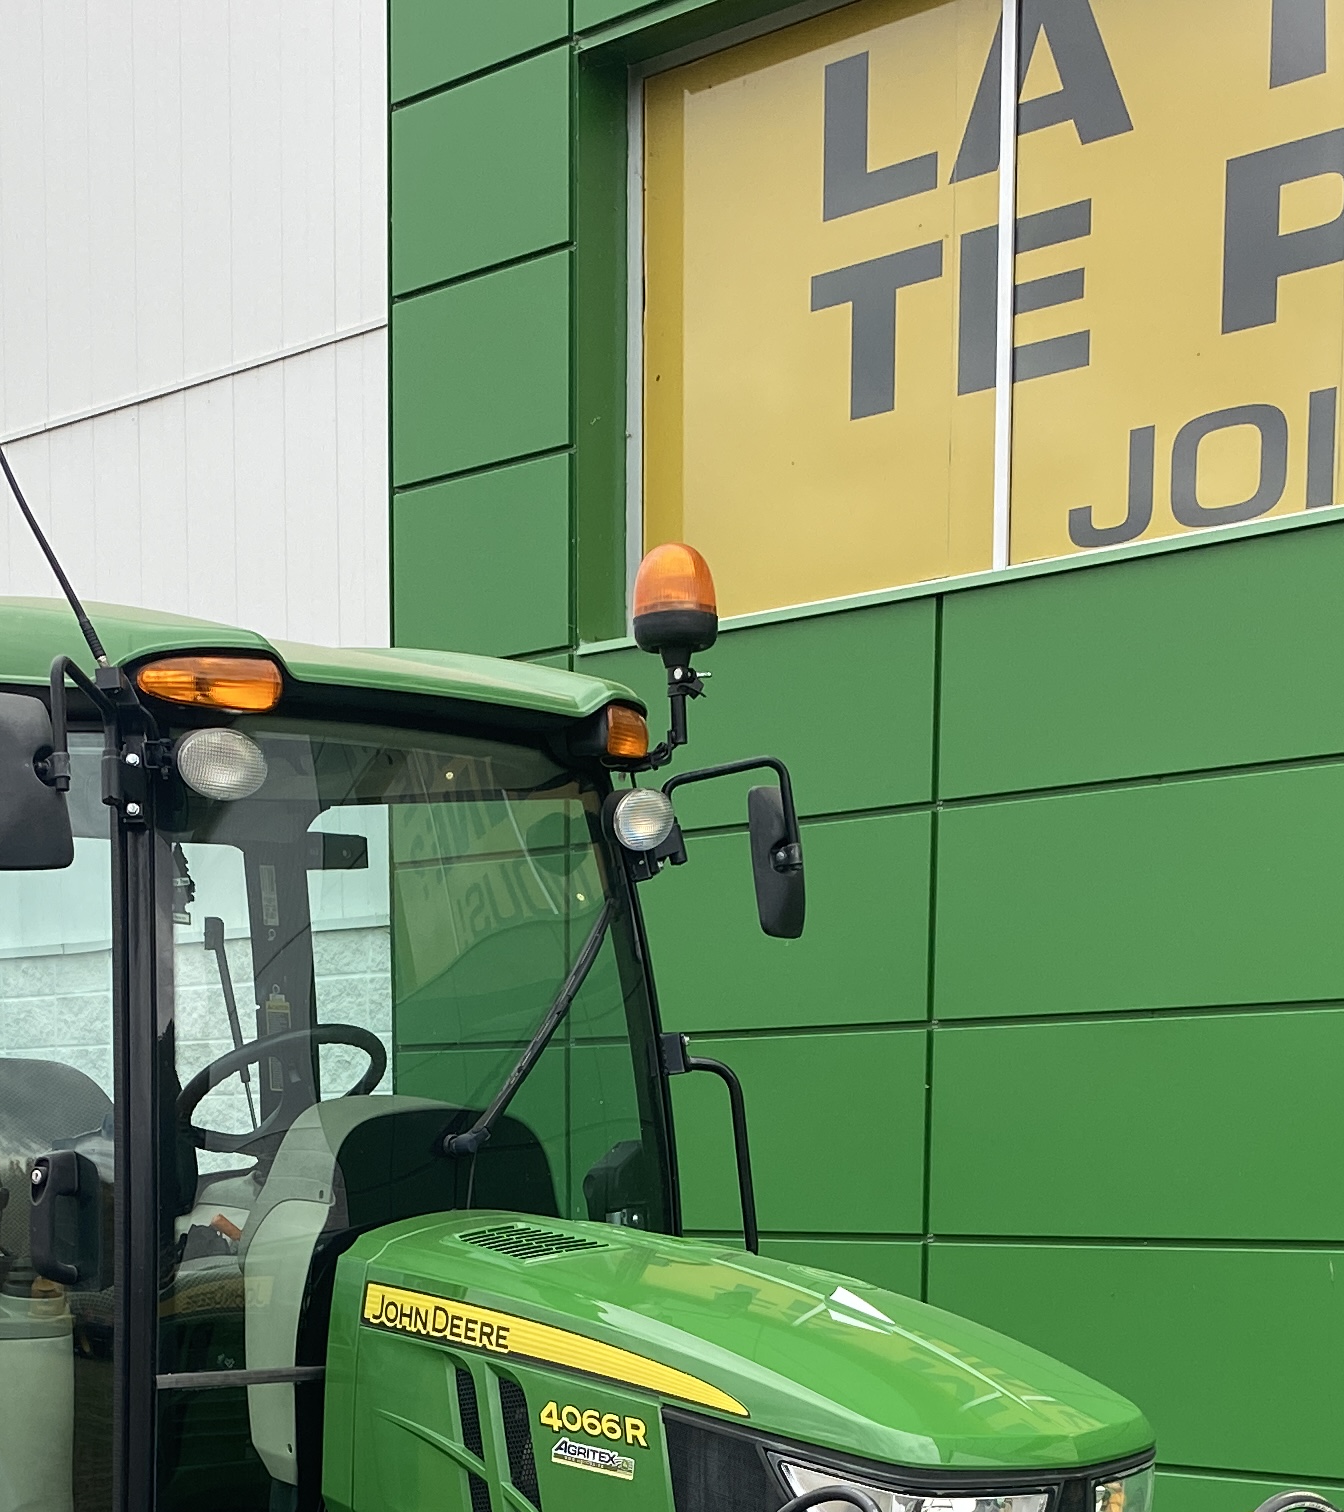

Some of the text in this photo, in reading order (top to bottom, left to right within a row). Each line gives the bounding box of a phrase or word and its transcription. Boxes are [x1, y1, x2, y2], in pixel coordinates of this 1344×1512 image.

[822, 0, 1134, 221] LA
[810, 198, 1091, 420] TE
[372, 1294, 511, 1350] JOHN DEERE
[539, 1400, 650, 1449] 4066R
[554, 1439, 617, 1466] AGRITEX
